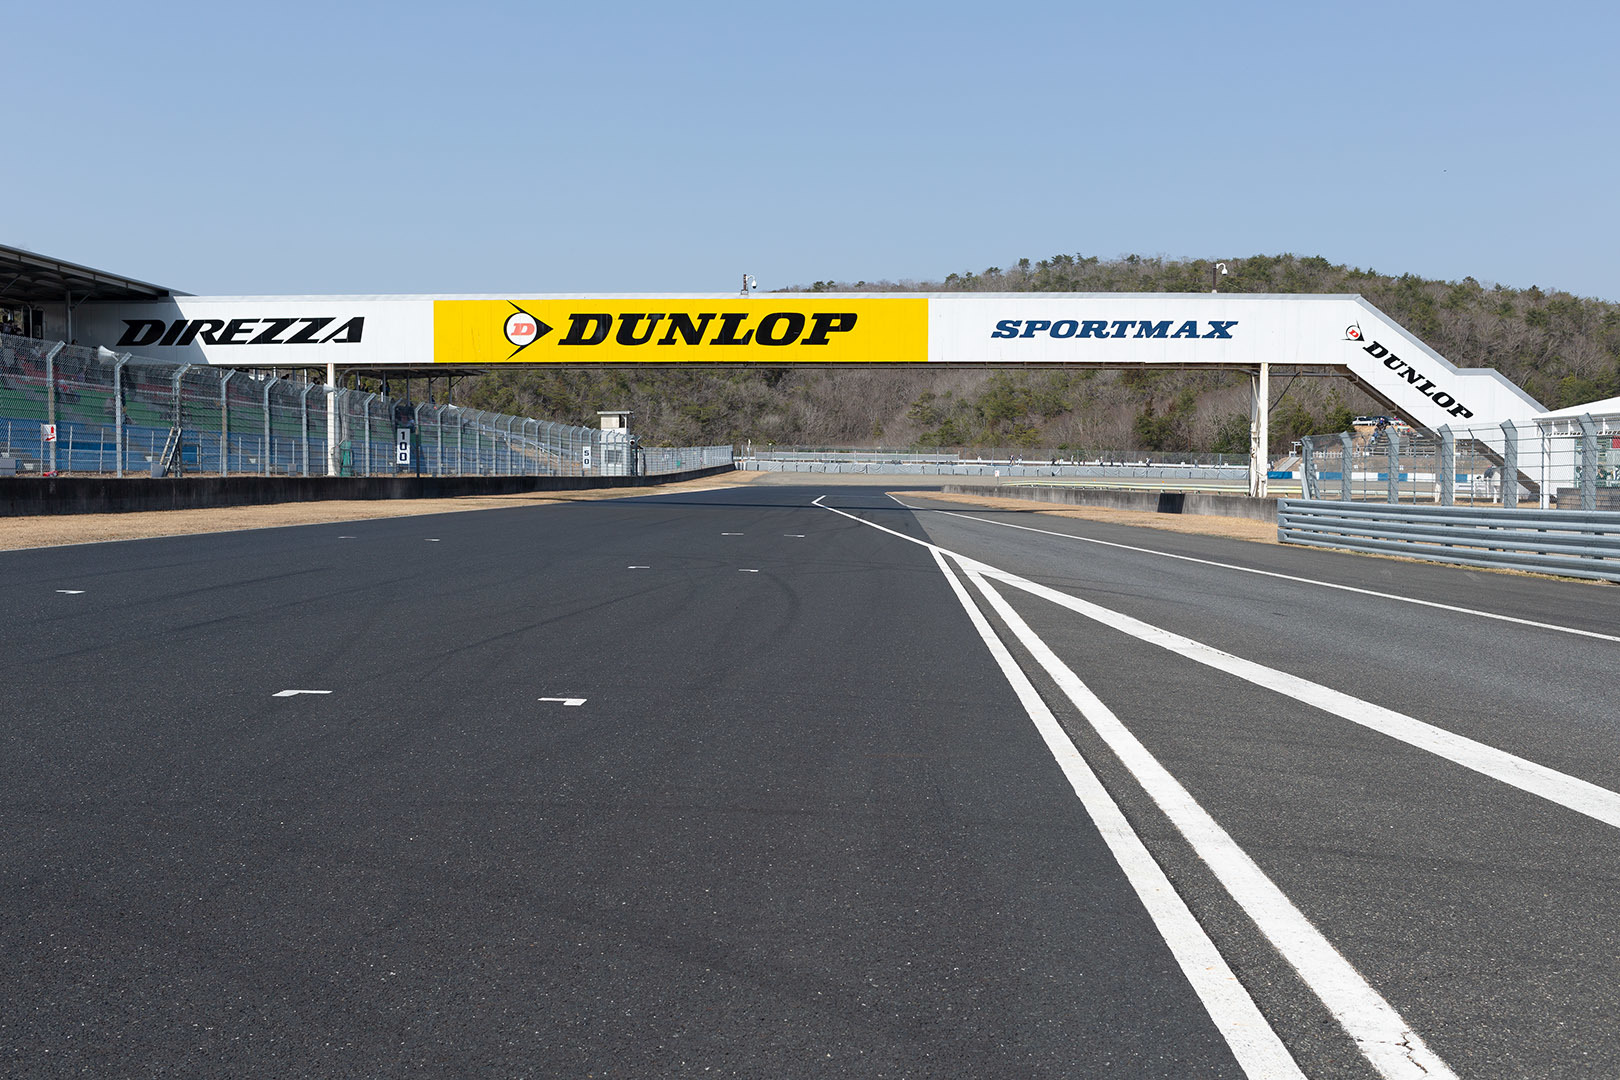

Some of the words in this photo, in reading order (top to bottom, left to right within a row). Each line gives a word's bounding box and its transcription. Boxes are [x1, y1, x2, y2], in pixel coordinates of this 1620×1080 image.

[116, 316, 365, 346] DIREZZA
[511, 322, 535, 336] D
[557, 312, 858, 347] DUNLOP
[990, 319, 1238, 339] SPORTMAX
[1362, 340, 1474, 419] DUNLOP
[399, 431, 408, 461] 100
[583, 449, 590, 465] 50
